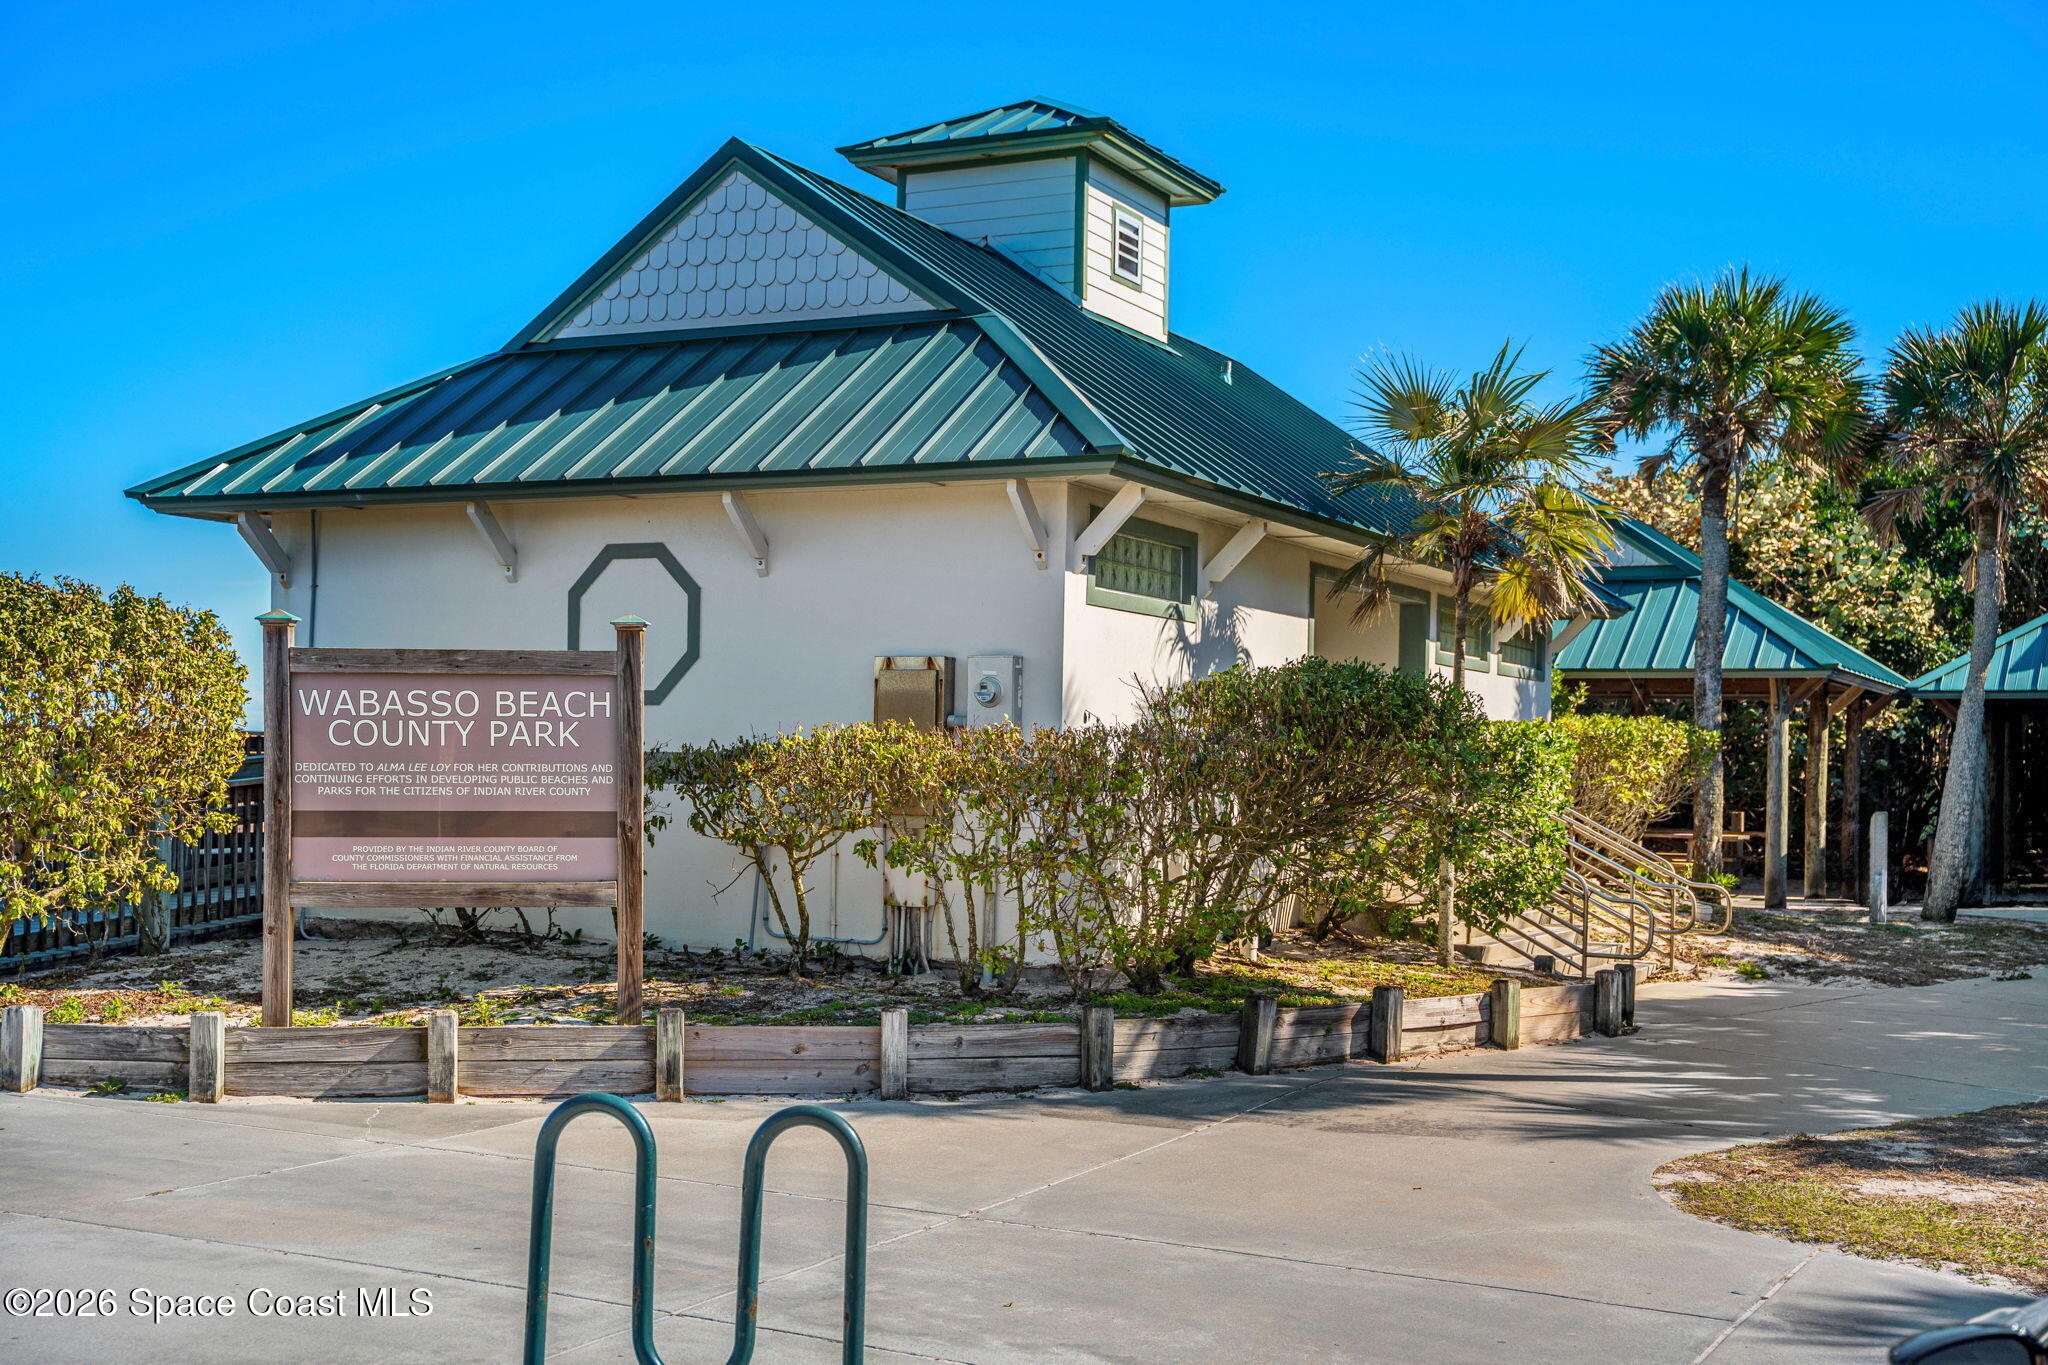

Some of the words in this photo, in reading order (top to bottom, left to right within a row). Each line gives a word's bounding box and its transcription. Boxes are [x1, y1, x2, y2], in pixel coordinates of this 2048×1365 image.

[298, 689, 480, 718] WABASSO
[495, 690, 611, 718] BEACH
[328, 719, 476, 747] COUNTY
[490, 720, 581, 747] PARK
[295, 762, 356, 772] DEDICATED
[358, 762, 374, 772] TO
[376, 762, 406, 772] ALMA
[408, 762, 428, 772] LEE
[430, 762, 451, 772] LOY
[453, 762, 475, 773] FOR
[477, 763, 499, 773] HER
[501, 763, 589, 773] CONTRIBUTIONS
[591, 763, 613, 773] AND
[294, 774, 363, 784] CONTINUING
[365, 774, 413, 784] EFFORTS
[415, 774, 428, 784] IN
[430, 774, 498, 784] DEVELOPING
[500, 775, 538, 785] PUBLIC
[540, 775, 589, 785] BEACHES
[591, 775, 614, 785] AND
[317, 786, 352, 796] PARKS
[355, 786, 377, 796] FOR
[380, 786, 401, 796] THE
[403, 786, 453, 796] CITIZENS
[455, 786, 471, 796] OF
[473, 786, 512, 796] INDIAN
[514, 786, 546, 796] RIVER
[549, 786, 591, 796] COUNTY
[352, 845, 394, 853] PROVIDED
[395, 845, 407, 853] BY
[408, 845, 425, 853] THE
[426, 845, 456, 853] INDIAN
[457, 845, 481, 853] RIVER
[483, 845, 516, 853] COUNTY
[517, 845, 545, 853] BOARD
[547, 845, 558, 853] OF
[331, 854, 365, 862] COUNTY
[366, 854, 435, 862] COMMISSIONERS
[436, 854, 458, 862] WITH
[460, 854, 503, 862] FINANCIAL
[504, 854, 554, 862] ASSISTANCE
[555, 854, 578, 862] FROM
[352, 863, 368, 871] THE
[369, 863, 405, 871] FLORIDA
[406, 863, 459, 871] DEPARTMENT
[460, 863, 472, 871] OF
[473, 863, 510, 871] NATURAL
[511, 863, 559, 871] RESOURCES
